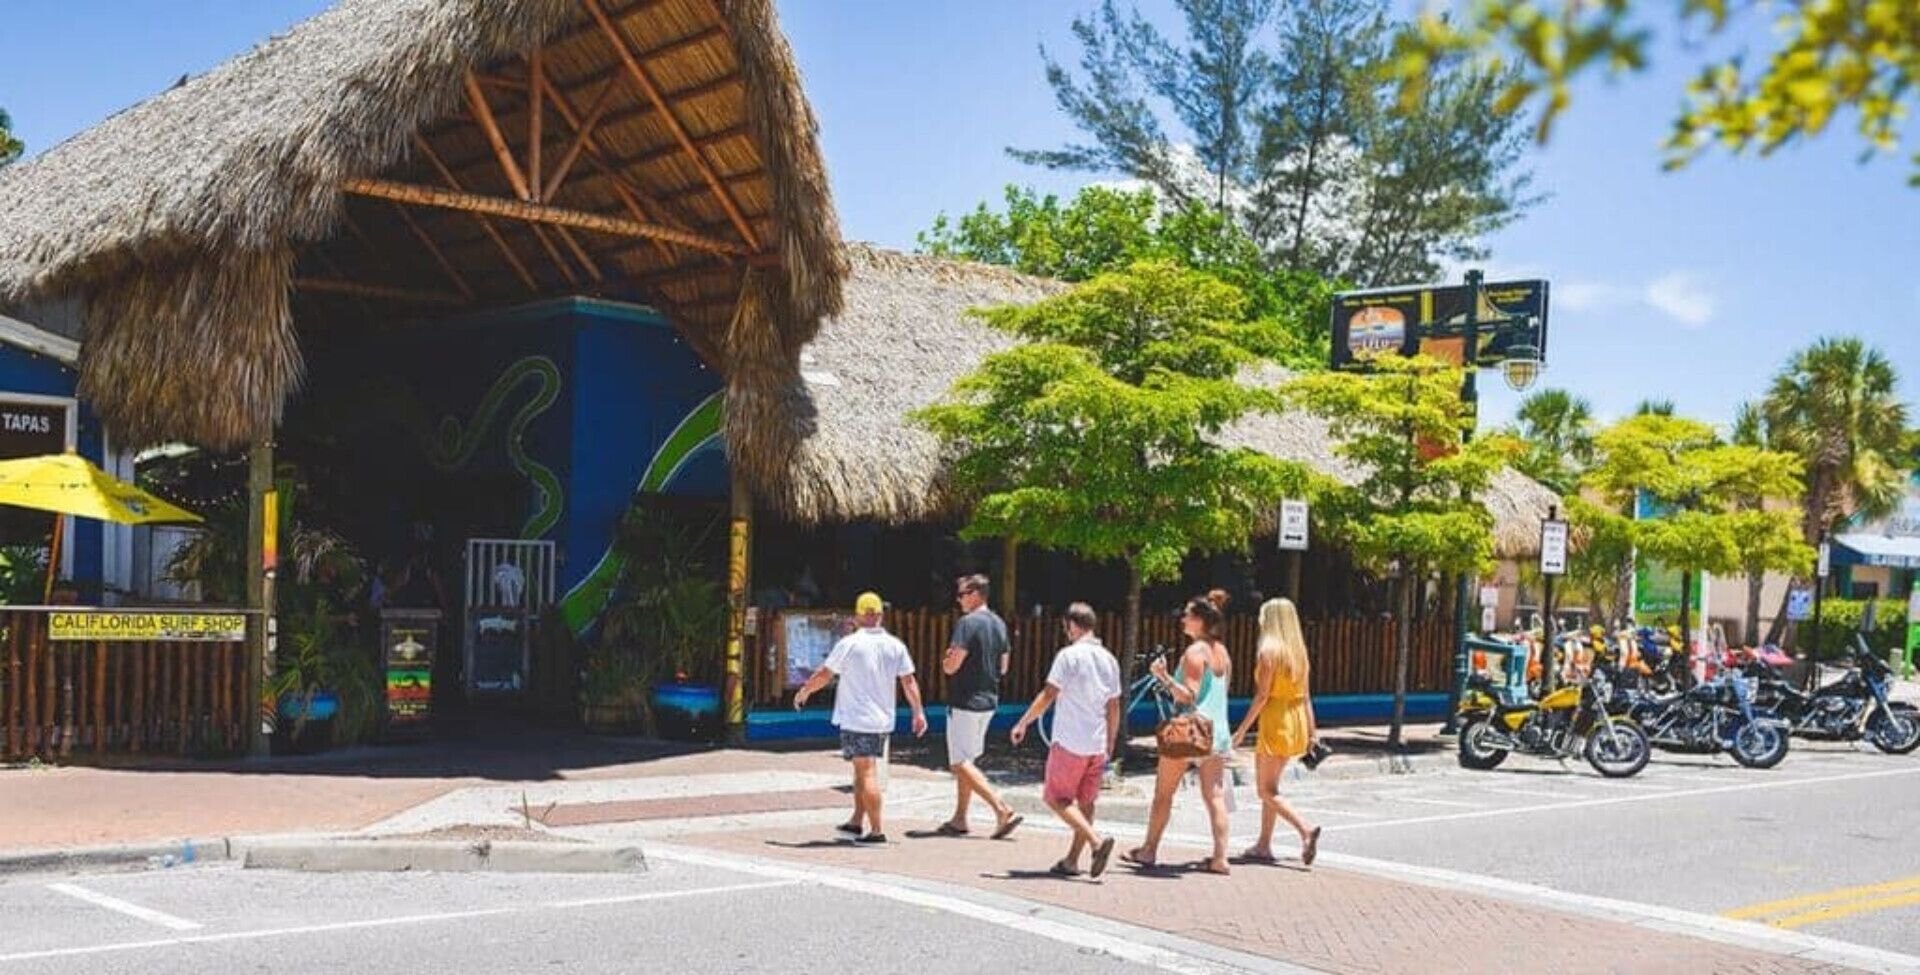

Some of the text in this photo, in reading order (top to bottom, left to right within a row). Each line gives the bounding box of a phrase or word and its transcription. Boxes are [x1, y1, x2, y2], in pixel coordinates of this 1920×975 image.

[2, 413, 50, 433] TAPAS
[52, 614, 242, 631] CALIFLORIDA SURF SHOP
